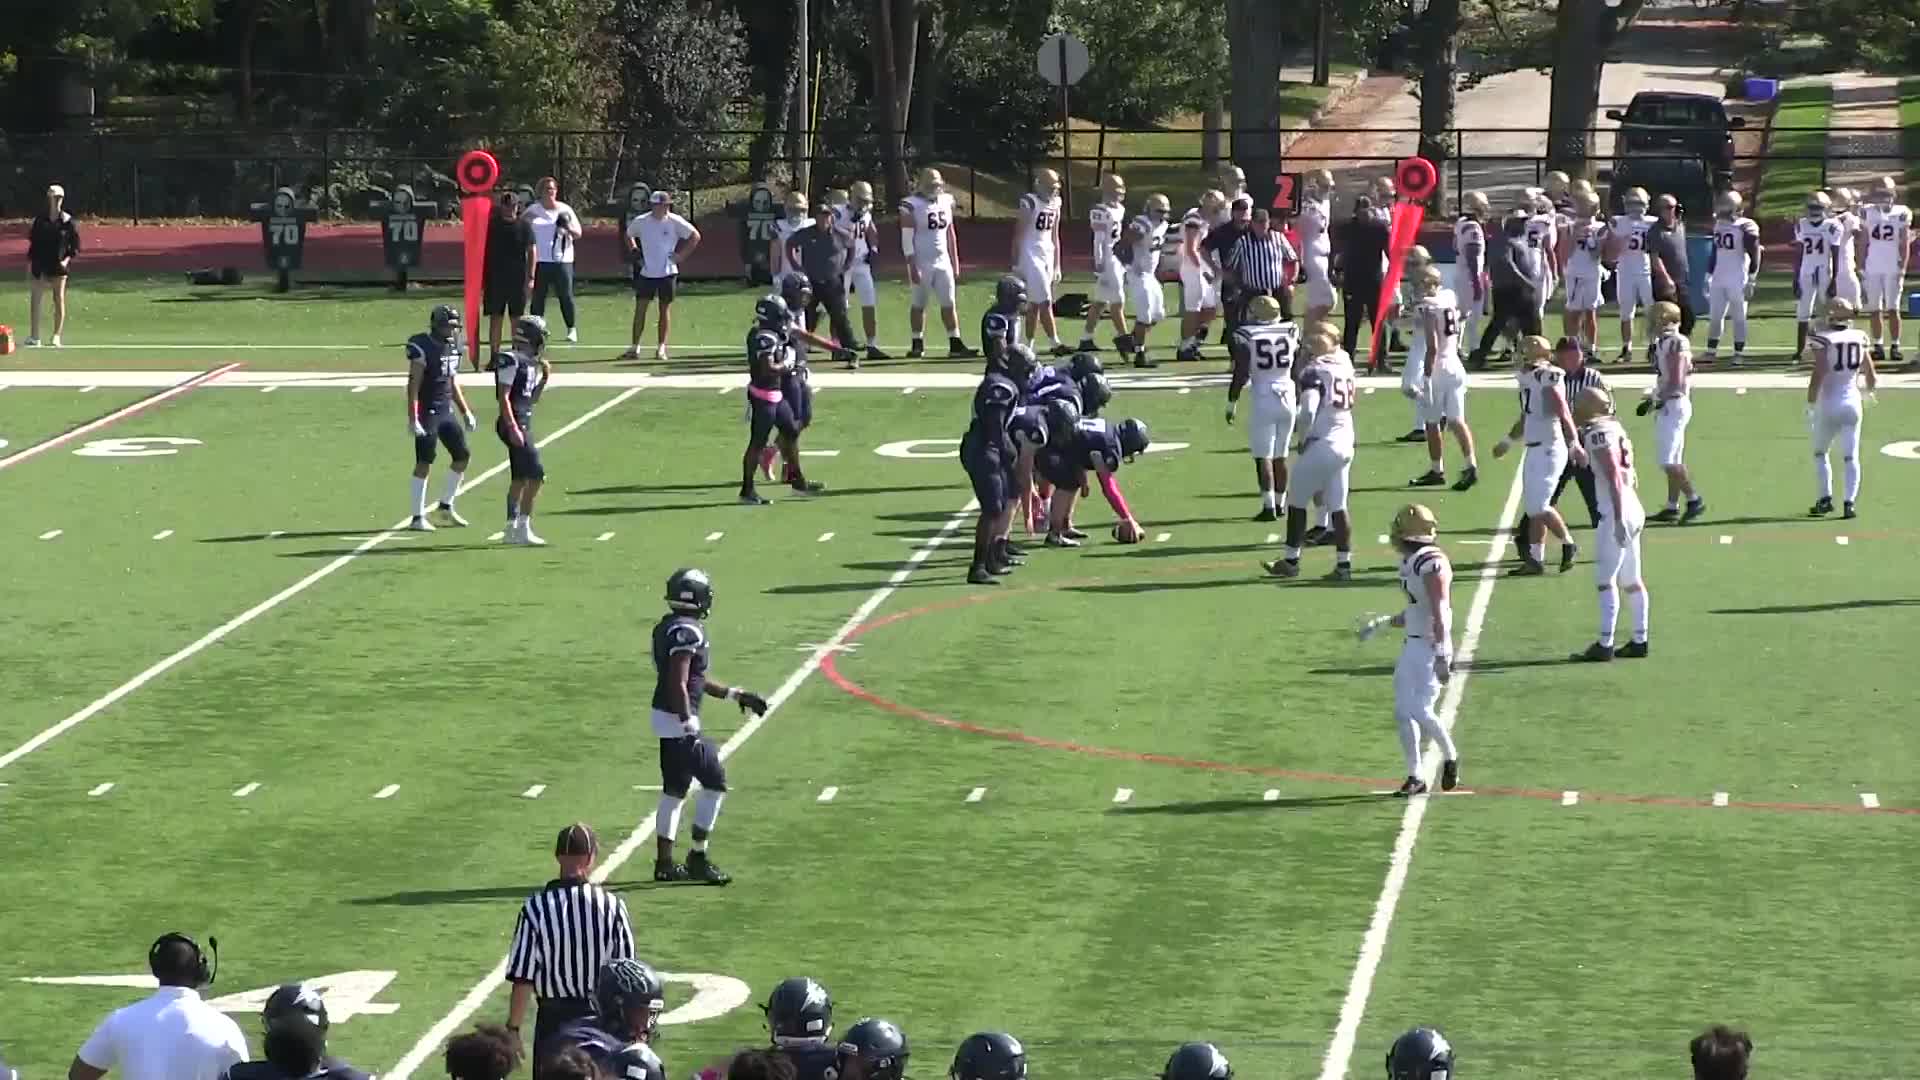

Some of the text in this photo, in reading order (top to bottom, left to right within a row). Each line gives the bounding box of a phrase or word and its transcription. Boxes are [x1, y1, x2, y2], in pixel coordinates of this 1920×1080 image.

[1272, 175, 1294, 208] 2
[269, 224, 299, 245] 70
[389, 221, 418, 242] 70
[1256, 336, 1290, 369] 52
[1833, 342, 1859, 371] 10
